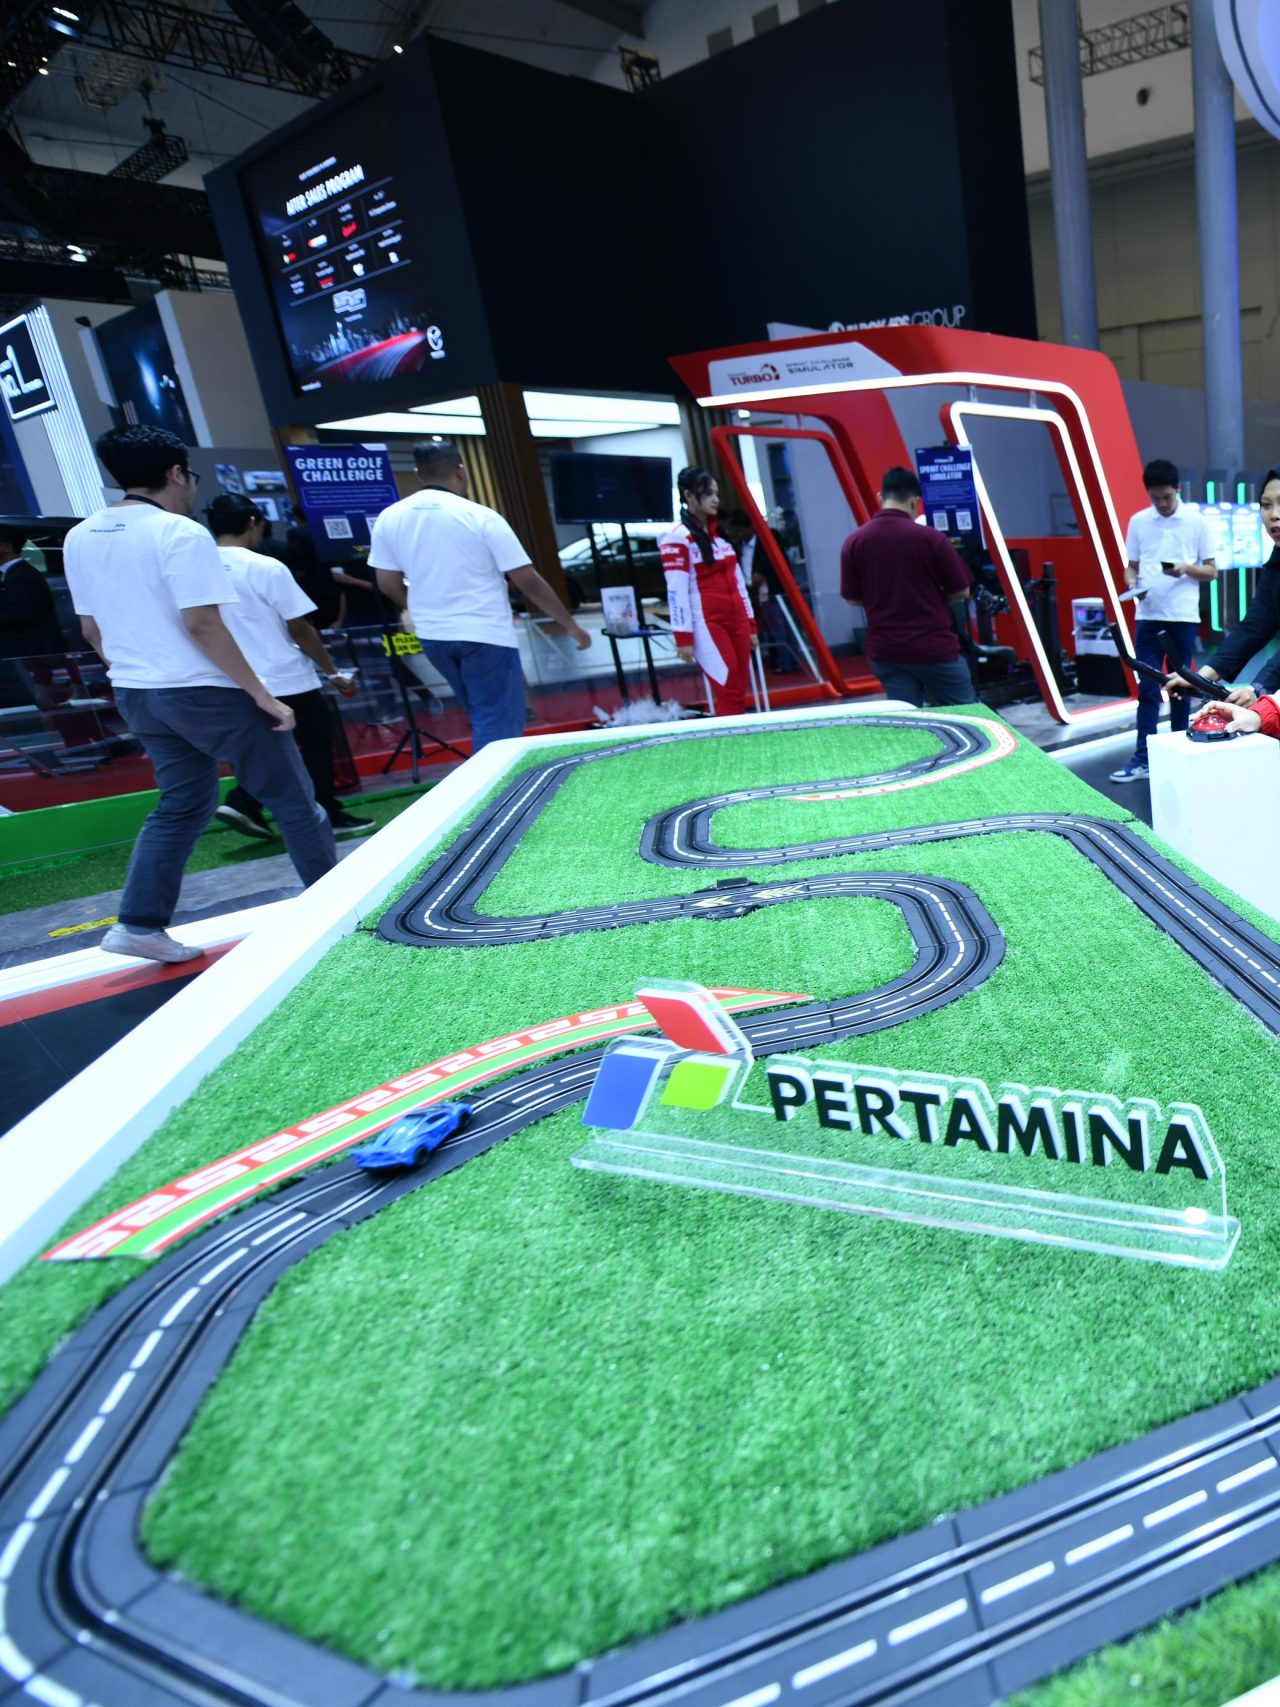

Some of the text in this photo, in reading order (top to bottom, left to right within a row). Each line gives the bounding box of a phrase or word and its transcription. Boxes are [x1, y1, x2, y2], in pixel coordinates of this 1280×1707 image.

[912, 305, 966, 327] GROUP
[788, 362, 854, 374] SIMULATOR
[730, 373, 772, 386] TURBO
[295, 457, 384, 470] GREEN GOLF
[302, 470, 384, 482] CHALLENGE
[766, 1070, 1213, 1181] PERTAMINA
